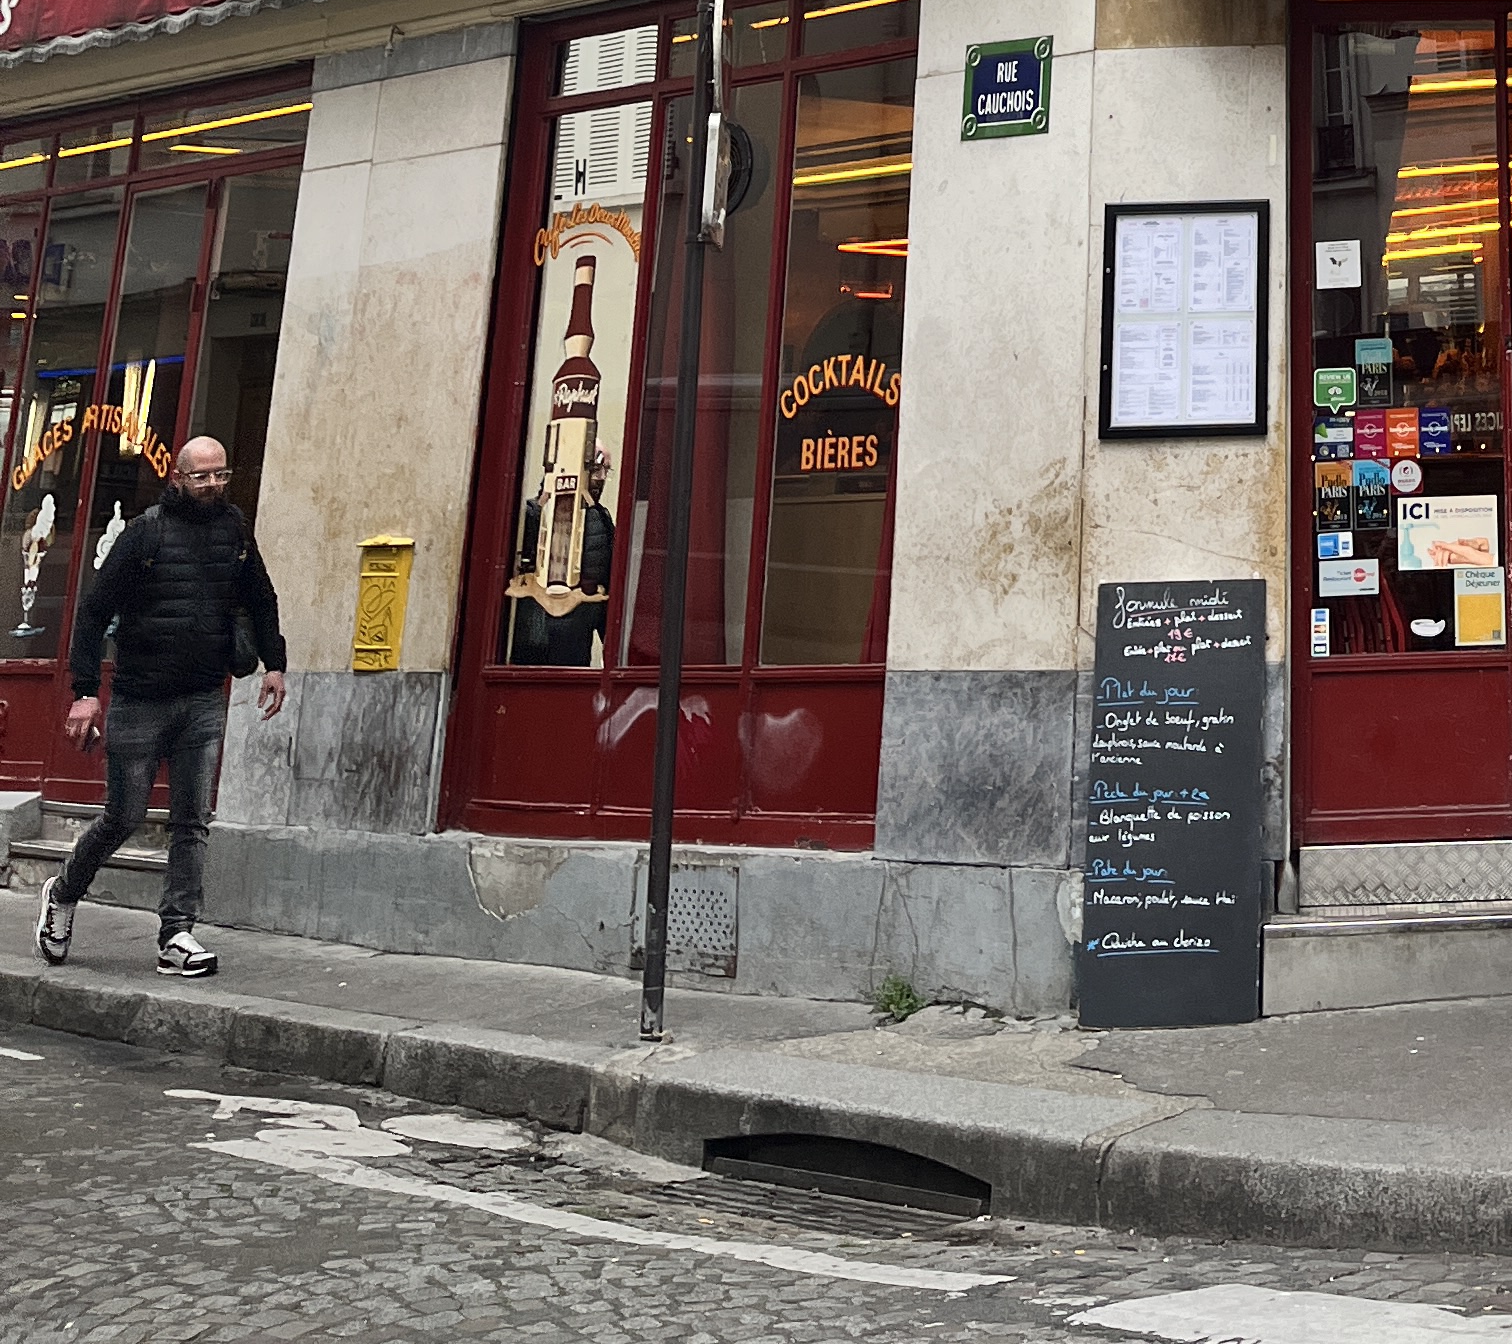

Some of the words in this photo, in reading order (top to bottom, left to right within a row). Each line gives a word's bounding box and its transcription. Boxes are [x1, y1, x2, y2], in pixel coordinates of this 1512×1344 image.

[996, 61, 1018, 83] RUE
[977, 89, 1034, 116] CAUCHOIS
[781, 354, 902, 419] COCKTAILS
[12, 416, 74, 491] GLACES
[801, 429, 879, 470] BIÈRES
[556, 477, 576, 490] BAR
[1321, 485, 1348, 499] PARIS
[1359, 484, 1386, 497] PARIS
[1402, 502, 1430, 520] ICI
